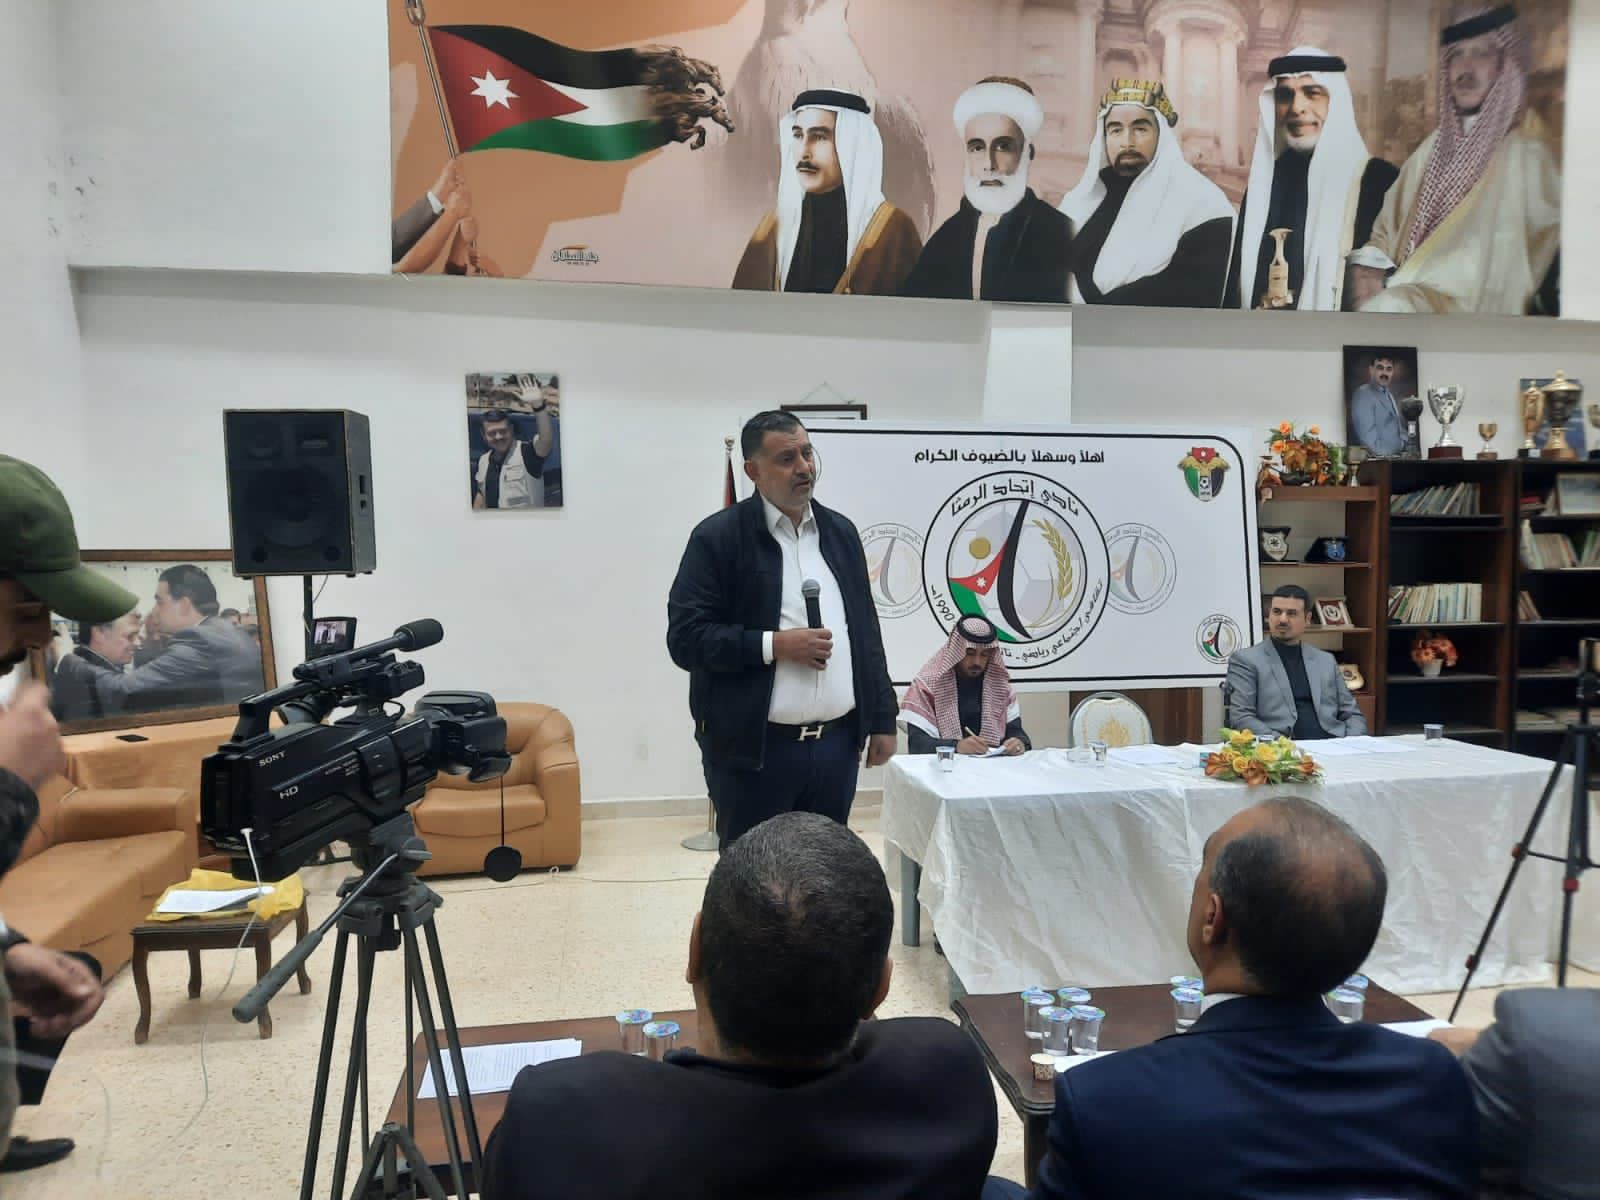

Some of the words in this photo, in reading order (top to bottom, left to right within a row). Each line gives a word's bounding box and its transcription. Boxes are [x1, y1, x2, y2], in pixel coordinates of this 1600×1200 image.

[914, 448, 958, 464] الكرام
[961, 448, 1026, 465] بالضيوف
[1040, 488, 1079, 516] نادي
[259, 750, 286, 767] SONY
[279, 785, 299, 800] HD
